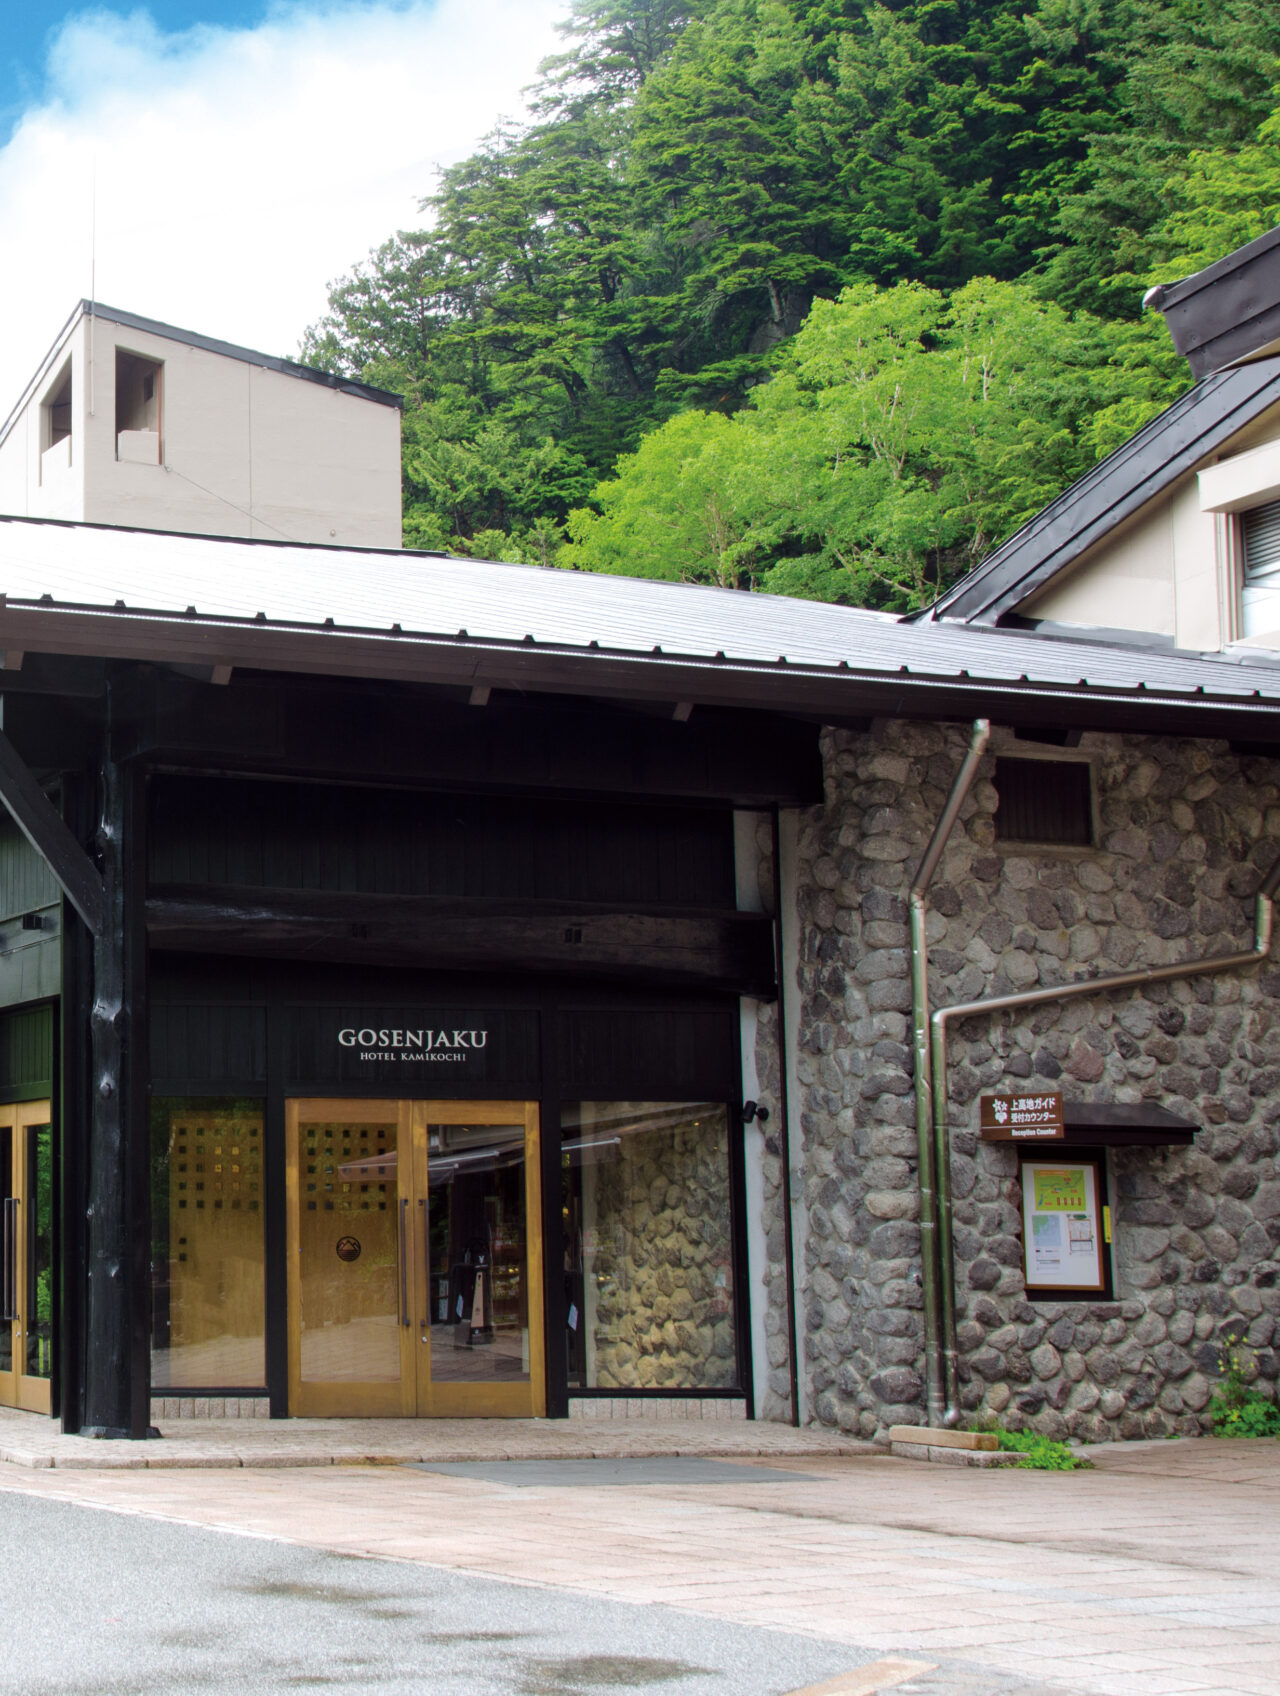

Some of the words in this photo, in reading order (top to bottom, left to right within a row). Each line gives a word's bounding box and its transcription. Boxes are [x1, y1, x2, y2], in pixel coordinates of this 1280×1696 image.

[338, 1029, 488, 1052] GOSENJAKU
[360, 1052, 396, 1061] HOTEL
[401, 1052, 466, 1062] KAMIKOCHI
[1010, 1097, 1056, 1111] 上高地ガイド
[1010, 1111, 1056, 1123] 受付カウンター
[1011, 1128, 1036, 1137] Reception
[1036, 1128, 1057, 1136] Counter
